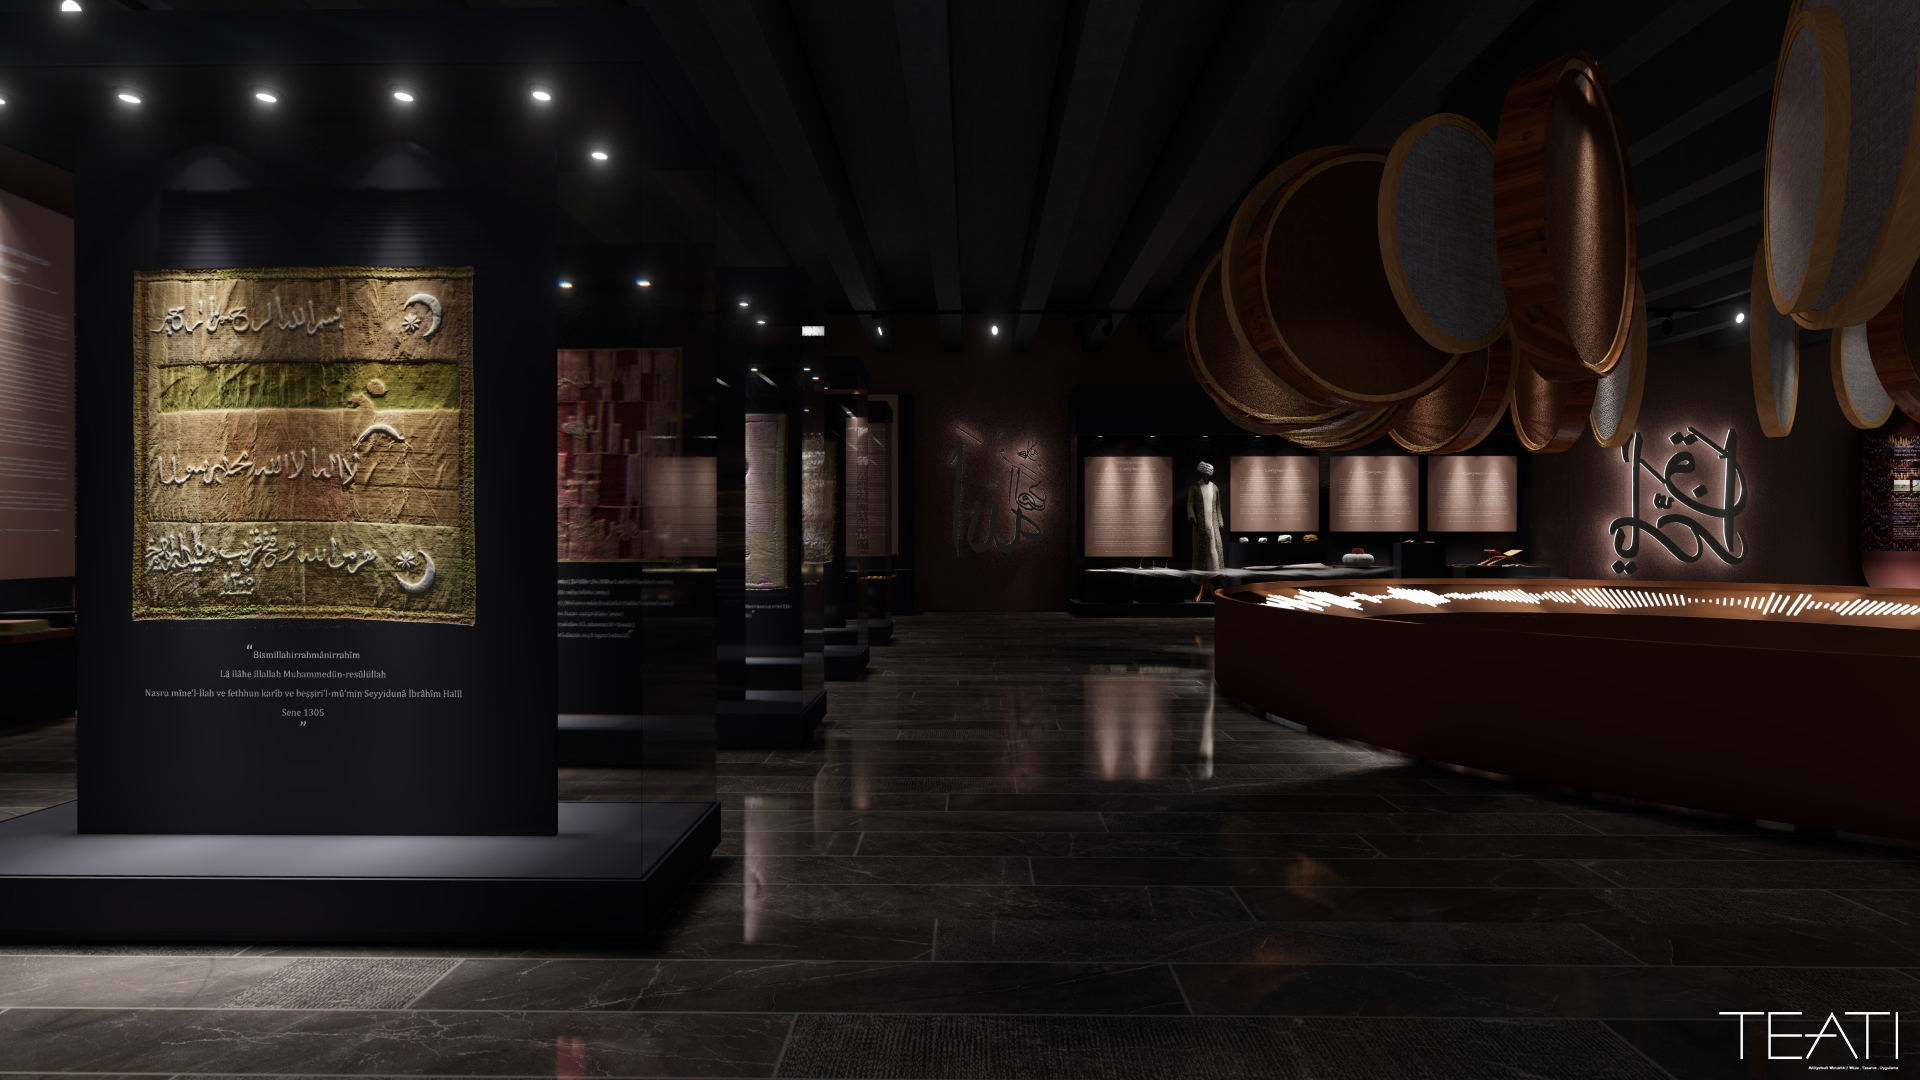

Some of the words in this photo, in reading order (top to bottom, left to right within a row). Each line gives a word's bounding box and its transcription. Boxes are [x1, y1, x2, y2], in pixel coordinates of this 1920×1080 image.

[220, 669, 231, 679] Lâ
[232, 669, 252, 679] ilâhe
[253, 669, 282, 679] illallah
[144, 688, 170, 698] Nasru
[216, 690, 226, 698] ve
[227, 688, 260, 698] fethhun
[284, 690, 295, 698] ve
[281, 707, 302, 717] Sene
[303, 707, 325, 717] 1305
